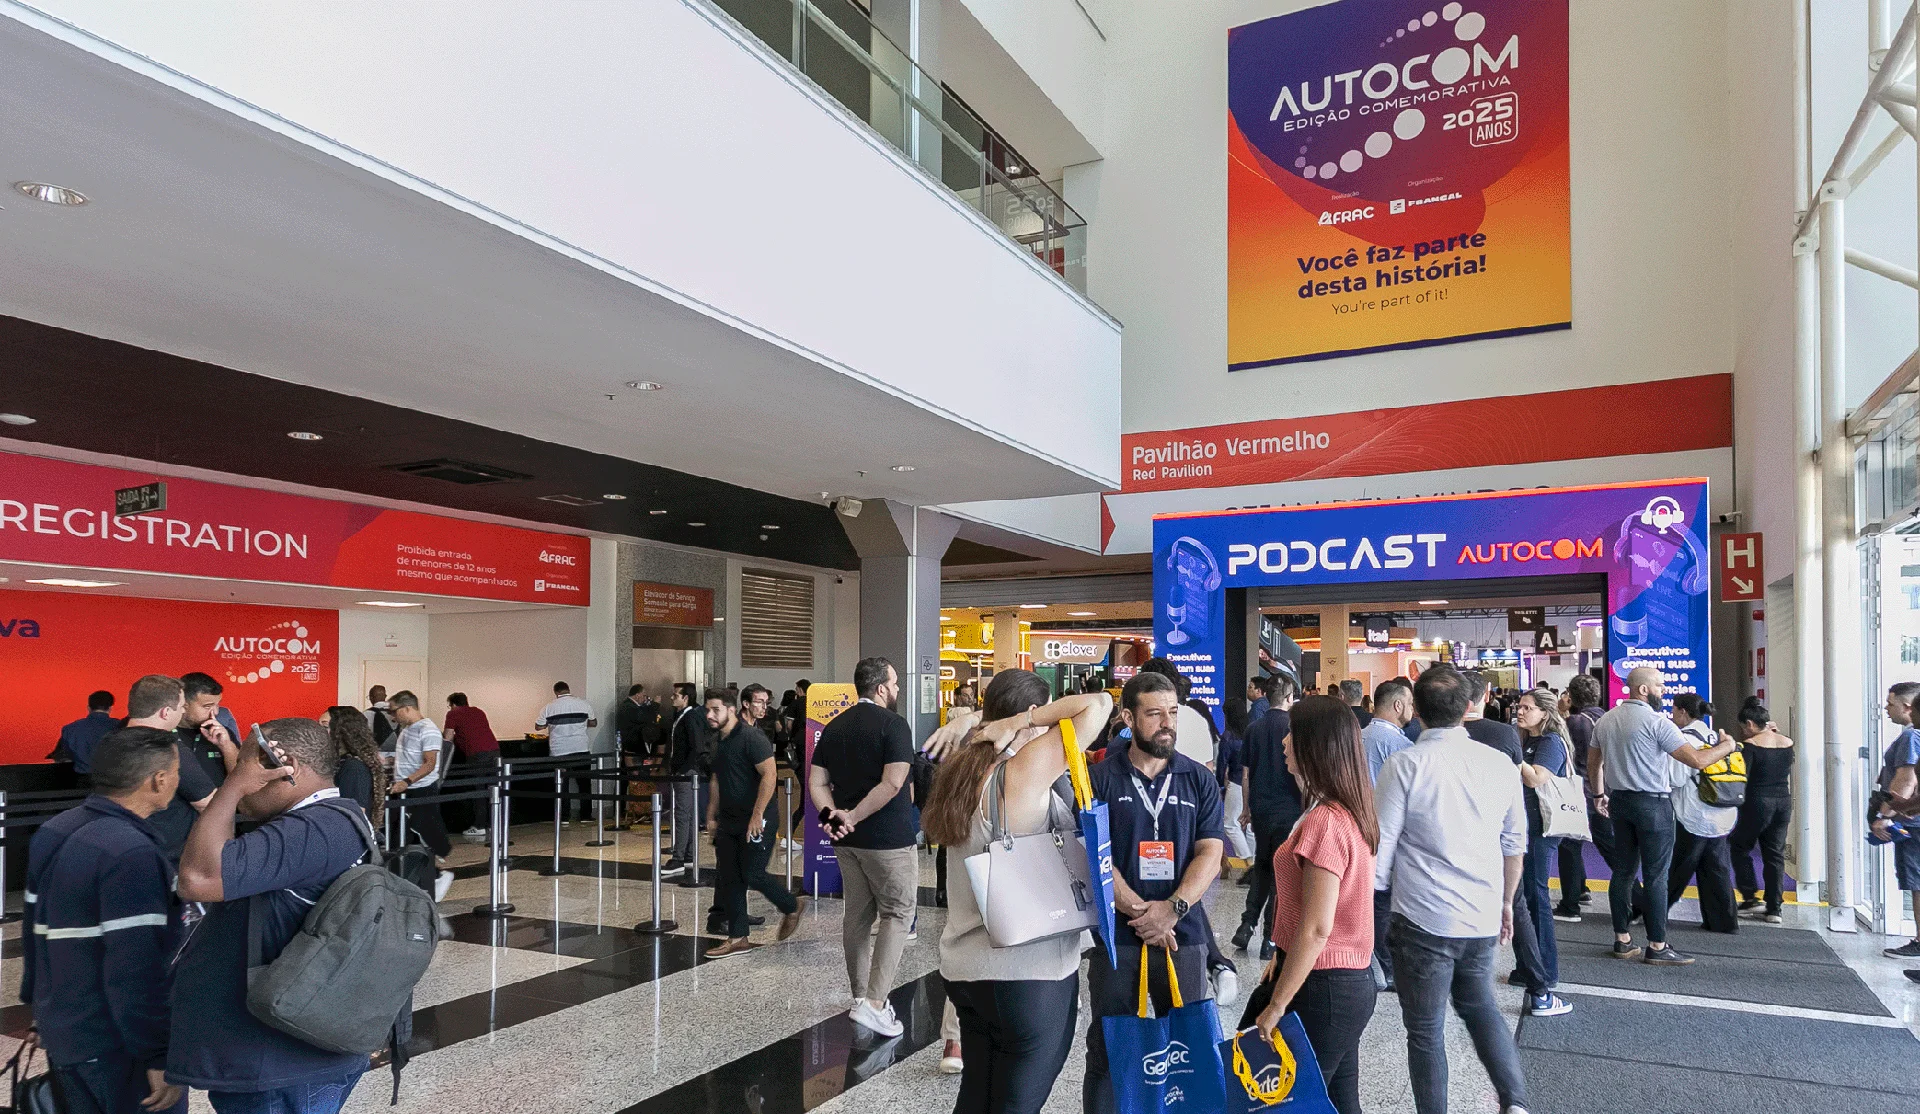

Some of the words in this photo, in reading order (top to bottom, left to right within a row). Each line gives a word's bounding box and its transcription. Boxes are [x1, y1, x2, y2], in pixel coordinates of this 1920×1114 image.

[1269, 34, 1519, 121] AUTOCOM
[1283, 109, 1351, 132] EDIÇÃO
[1358, 75, 1511, 115] COMEMORATIVA
[1442, 97, 1513, 130] 2025
[1476, 120, 1512, 141] ANOS
[1408, 192, 1463, 207] FRANCAL
[1297, 248, 1359, 275] Você
[1366, 245, 1405, 265] faz
[1413, 232, 1487, 261] parte
[1298, 276, 1367, 299] desta
[1376, 254, 1487, 288] história!
[1331, 300, 1376, 315] You're
[1380, 294, 1411, 311] part
[1415, 290, 1431, 304] of
[1434, 289, 1448, 301] it!
[1132, 439, 1217, 465] Pavilhão
[1225, 430, 1330, 457] Vermelho
[1132, 467, 1156, 481] Red
[1161, 464, 1213, 479] Pavilion
[0, 499, 308, 559] REGISTRATION
[397, 544, 436, 557] Proibida
[438, 550, 472, 560] entrada
[1228, 533, 1447, 576] PODCAST
[1457, 537, 1603, 565] AUTOCOM
[1727, 537, 1755, 569] H
[397, 557, 409, 566] de
[411, 559, 452, 570] menores
[453, 562, 465, 571] de
[466, 563, 475, 572] 12
[476, 566, 497, 574] anos
[397, 569, 433, 580] mesmo
[434, 572, 452, 582] que
[453, 574, 518, 588] acompanhados
[546, 582, 580, 591] FRANCAL
[214, 637, 321, 654] AUTOCOM
[1062, 640, 1099, 656] clover
[1539, 632, 1554, 648] A
[221, 653, 253, 661] EDIÇÃO
[256, 653, 318, 661] COMEMORATIVA
[1166, 653, 1212, 662] Executivos
[1626, 646, 1690, 657] Executivos
[291, 662, 318, 673] 2025
[1195, 664, 1216, 673] suas
[1667, 659, 1697, 669] suas
